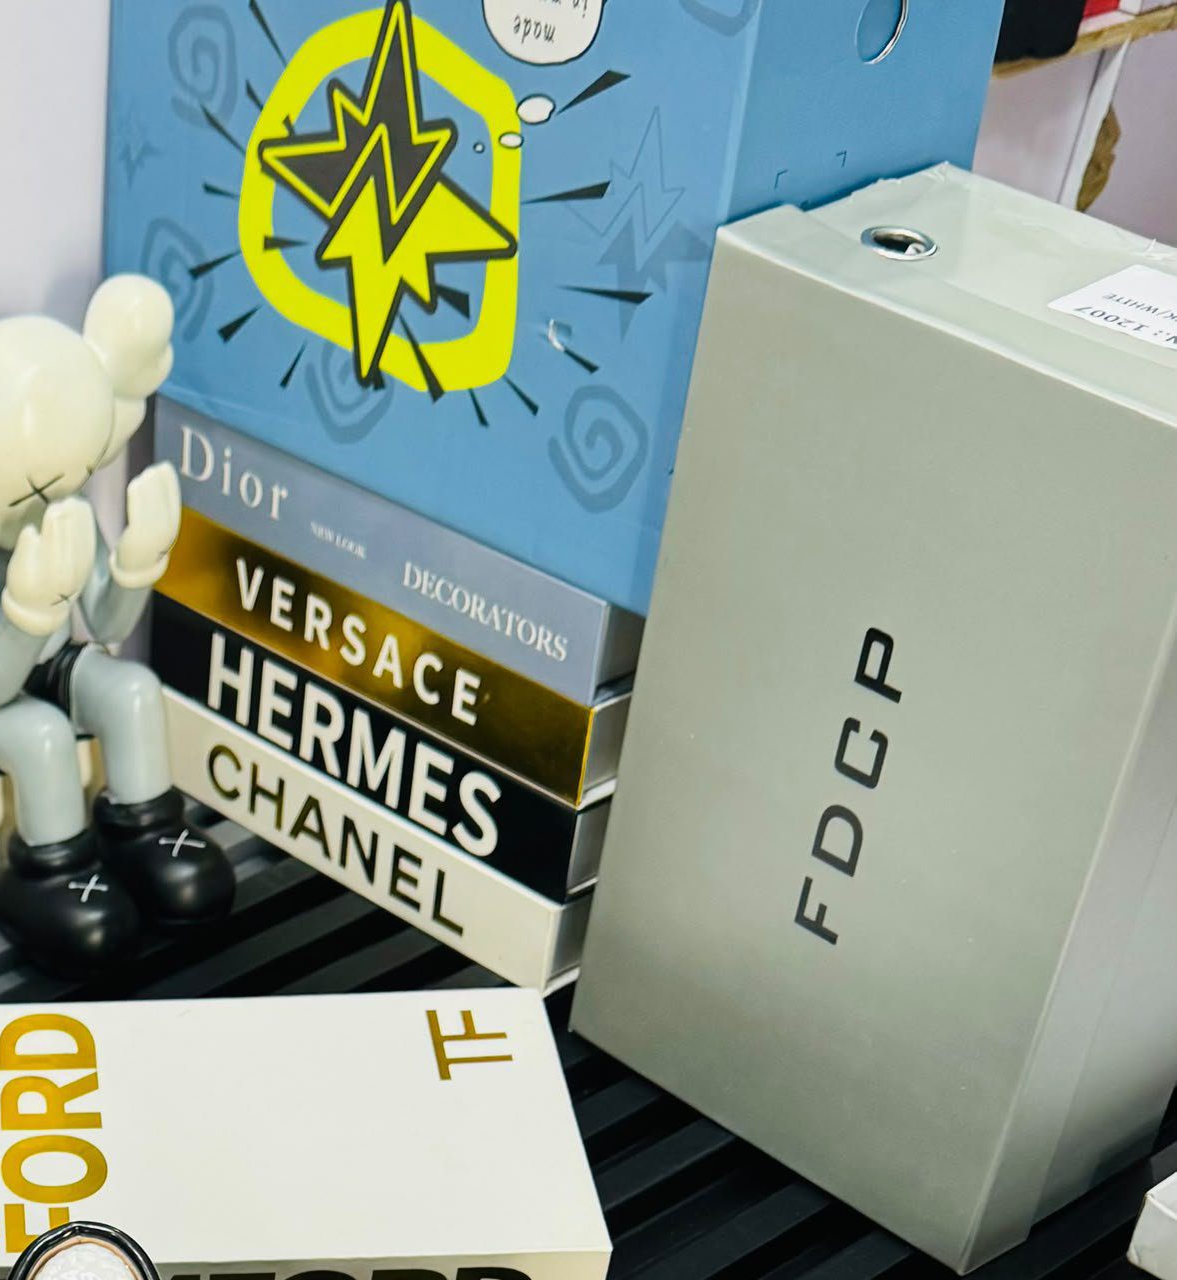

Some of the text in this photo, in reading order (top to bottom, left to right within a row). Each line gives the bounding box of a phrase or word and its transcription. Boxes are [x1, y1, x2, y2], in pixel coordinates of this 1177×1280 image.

[512, 14, 556, 44] made
[1073, 306, 1149, 332] 12007
[1102, 292, 1177, 322] K/WHITE
[179, 425, 288, 521] Dior
[335, 534, 367, 560] LOOK
[235, 557, 482, 726] VERSACE
[402, 561, 569, 662] DECORATORS
[207, 631, 503, 858] HERMES
[207, 743, 464, 938] CHANEL
[426, 1009, 514, 1081] TF
